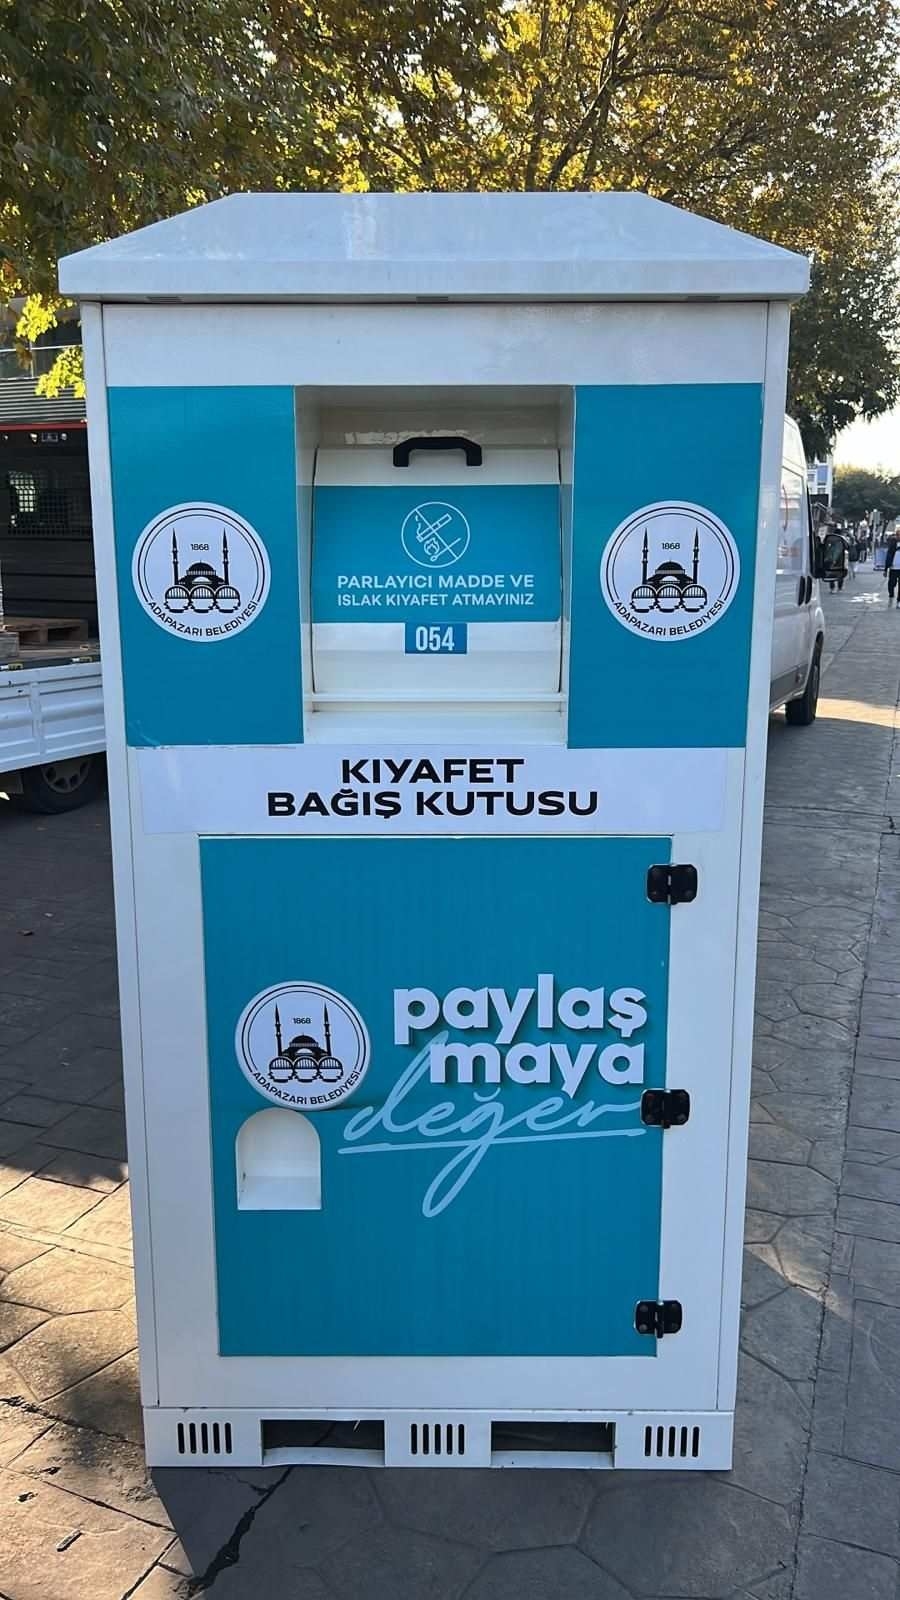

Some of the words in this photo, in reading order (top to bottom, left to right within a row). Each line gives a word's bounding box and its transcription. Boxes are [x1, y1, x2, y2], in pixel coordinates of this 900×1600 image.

[190, 543, 209, 551] 1868
[662, 542, 681, 550] 1868
[337, 575, 432, 589] PARLAYICI
[438, 574, 505, 588] MADDE
[510, 574, 535, 588] VE
[338, 593, 382, 607] ISLAK
[386, 593, 448, 607] KIYAFET
[452, 593, 535, 606] ATMAYINIZ
[148, 601, 202, 637] ADAPAZARI
[613, 601, 666, 636] ADAPAZARI
[415, 626, 455, 652] 054
[341, 758, 525, 784] KIYAFET
[267, 788, 401, 819] BAĞIŞ
[416, 790, 598, 816] KUTUSU
[292, 1017, 312, 1025] 1868
[393, 973, 648, 1046] paylaş
[430, 1041, 645, 1099] maya
[252, 1071, 307, 1105] ADAPAZARI
[342, 1030, 642, 1218] değer
